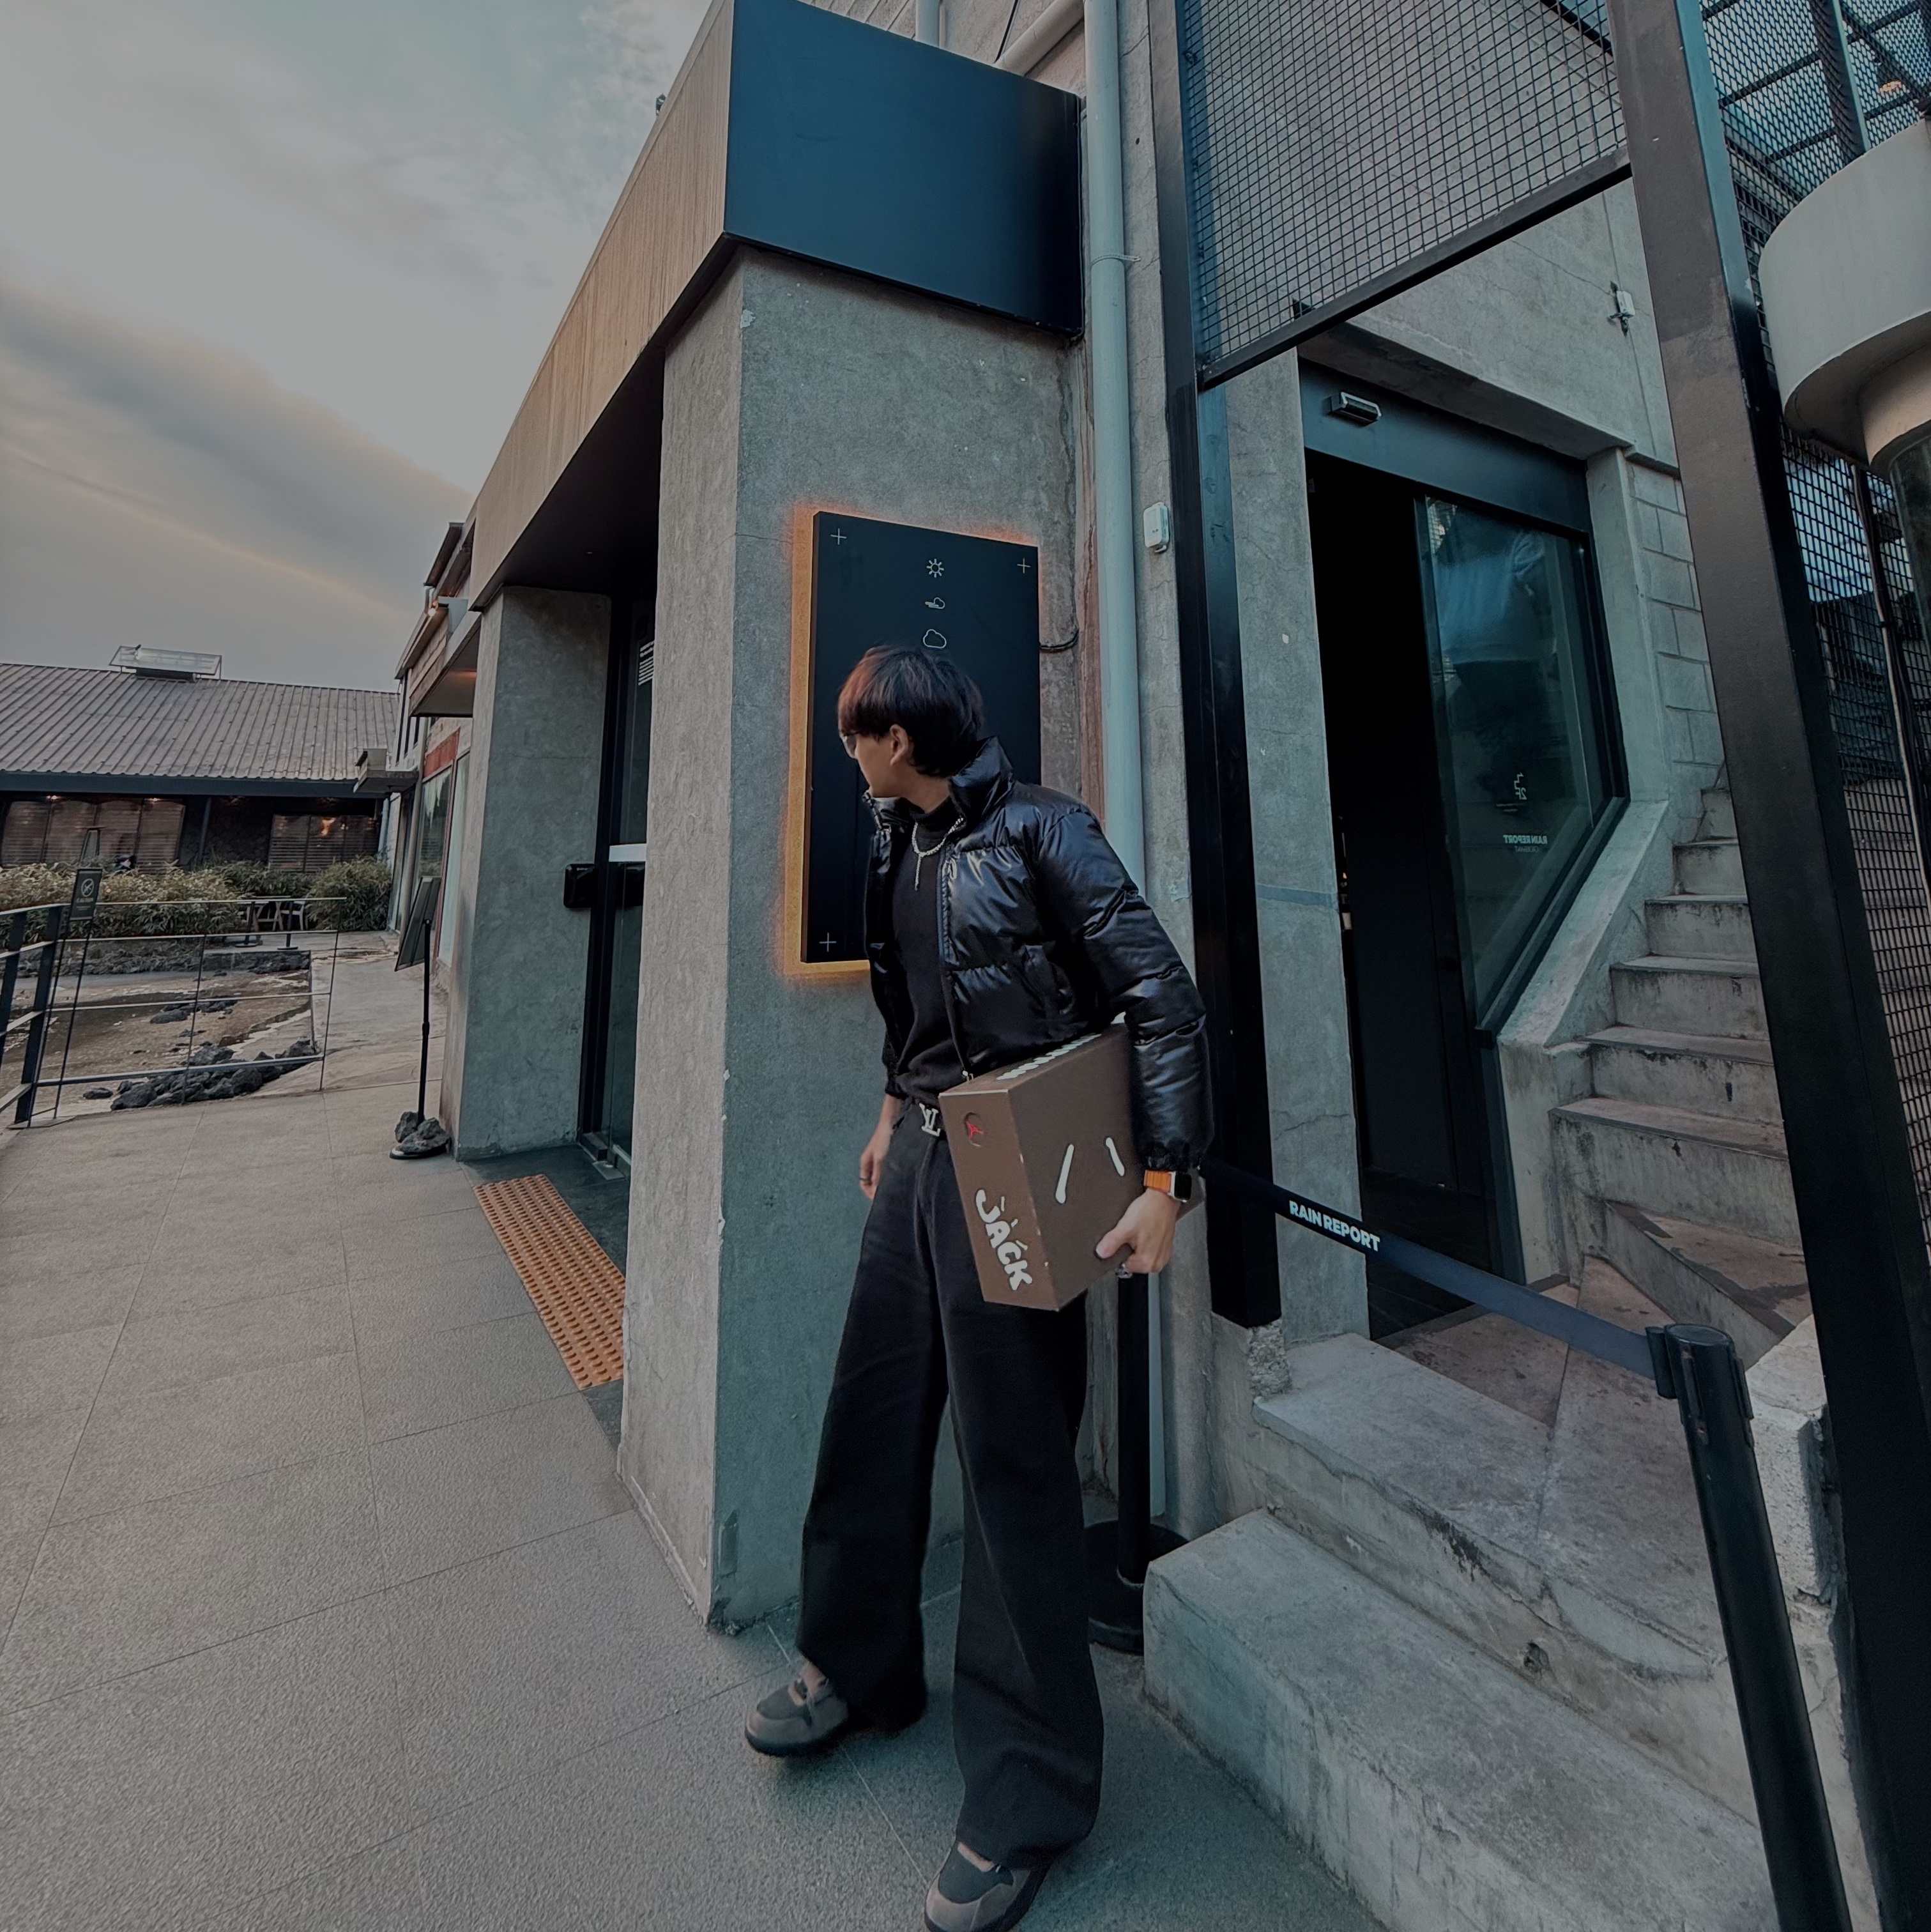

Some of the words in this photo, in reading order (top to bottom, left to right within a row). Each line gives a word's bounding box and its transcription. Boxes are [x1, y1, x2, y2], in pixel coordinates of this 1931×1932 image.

[975, 1189, 1033, 1291] JACK
[1288, 1200, 1322, 1227] RAIN
[1322, 1213, 1381, 1252] REPORT
